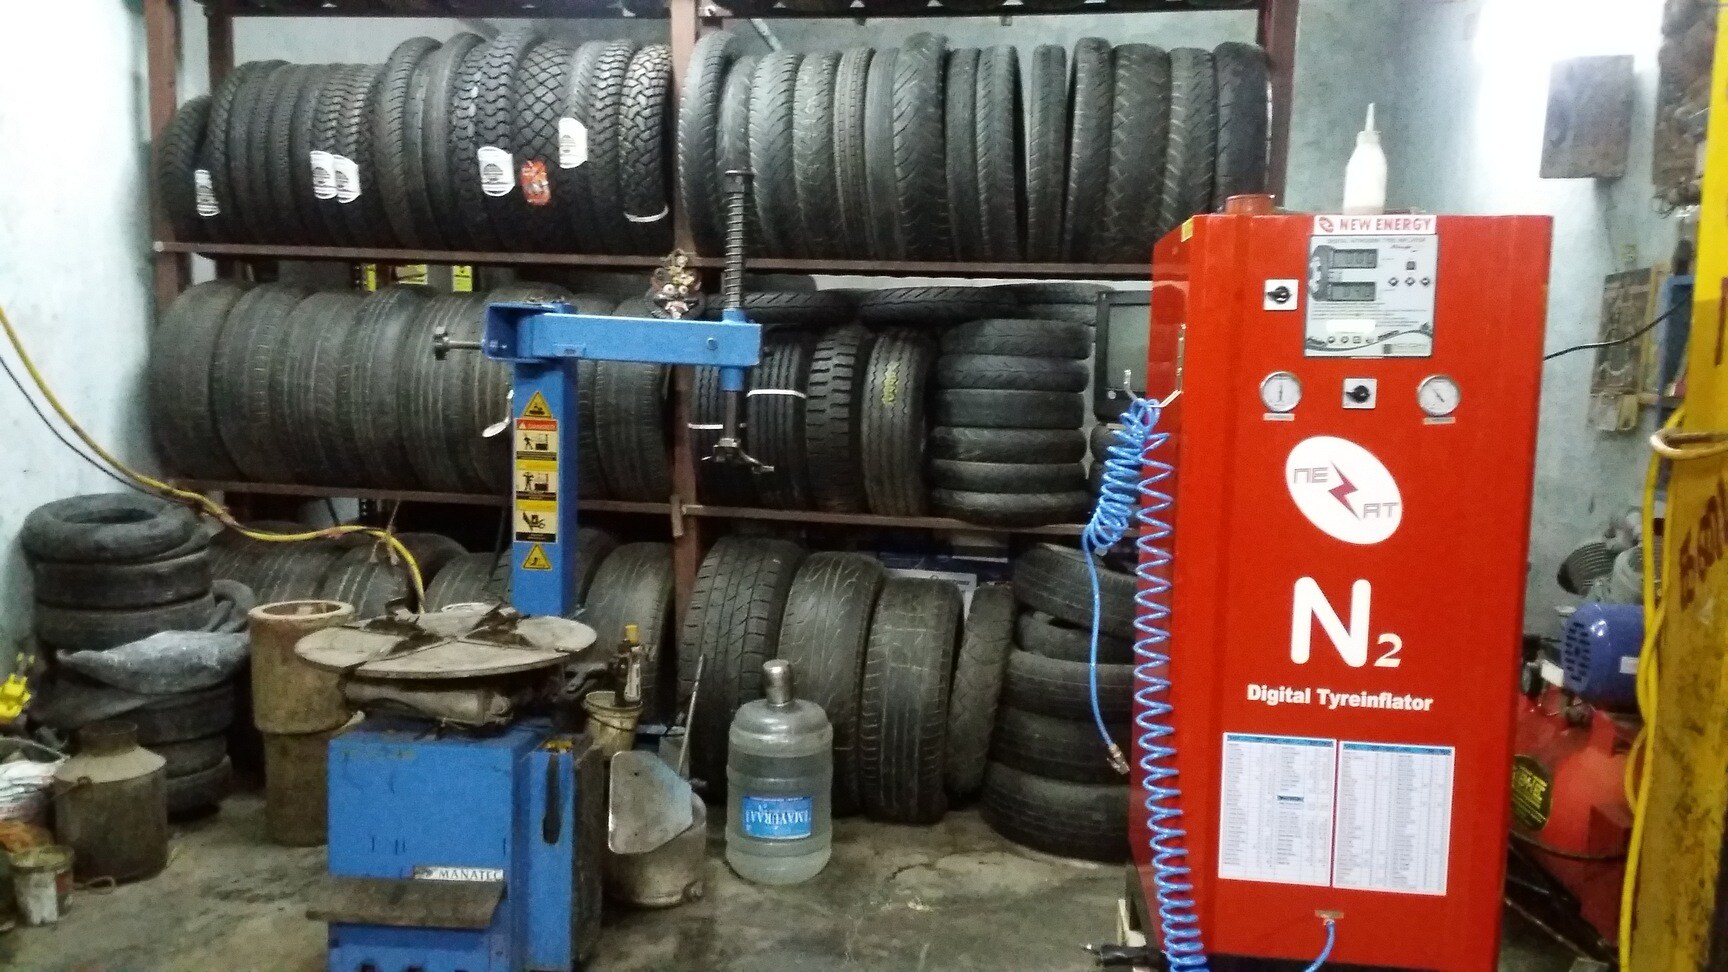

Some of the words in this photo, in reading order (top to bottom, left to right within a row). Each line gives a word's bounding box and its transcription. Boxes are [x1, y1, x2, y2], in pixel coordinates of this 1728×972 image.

[1339, 218, 1372, 231] NEW
[1375, 218, 1432, 231] ENERGY
[1247, 684, 1311, 706] Digital
[1316, 688, 1435, 712] Tyreinflator
